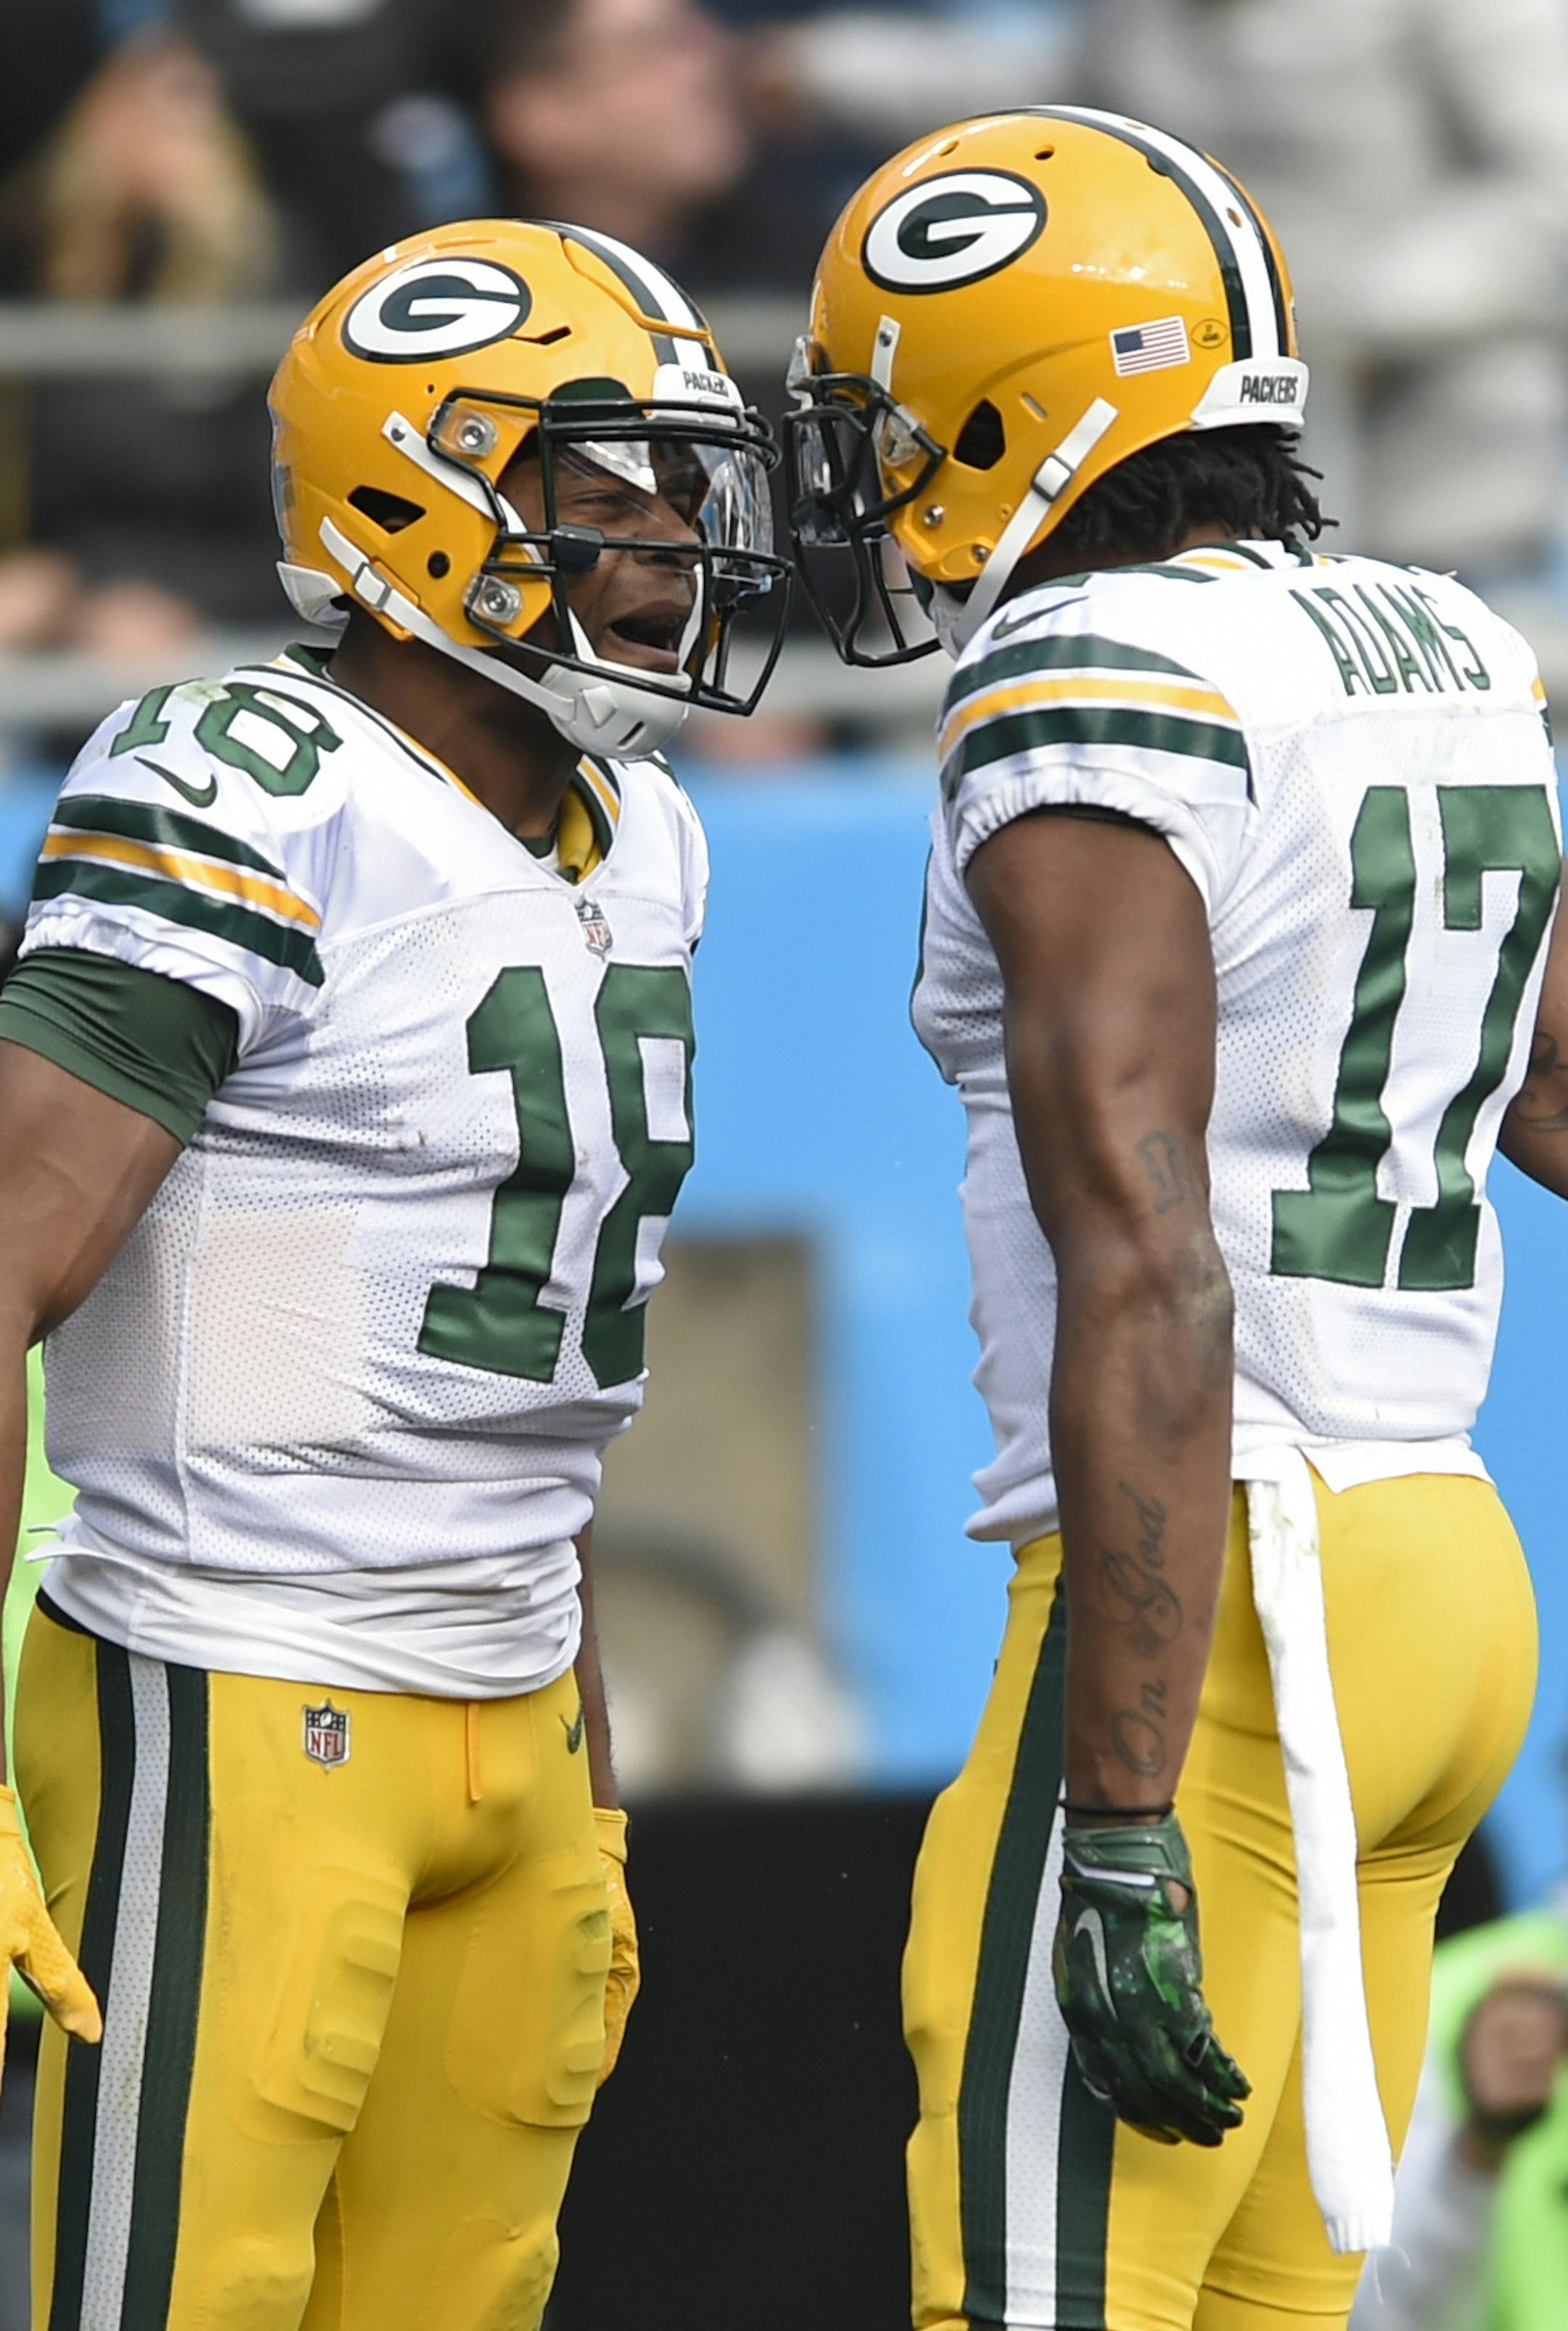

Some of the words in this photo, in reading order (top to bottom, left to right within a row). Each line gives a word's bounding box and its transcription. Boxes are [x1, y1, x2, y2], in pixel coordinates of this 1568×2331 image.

[865, 172, 1039, 285] G
[346, 258, 520, 356] G
[1239, 375, 1298, 404] PACKERS
[1288, 583, 1491, 696] ADAMS
[1270, 784, 1562, 1291] 17
[416, 962, 697, 1390] 18
[309, 1730, 343, 1758] NFL
